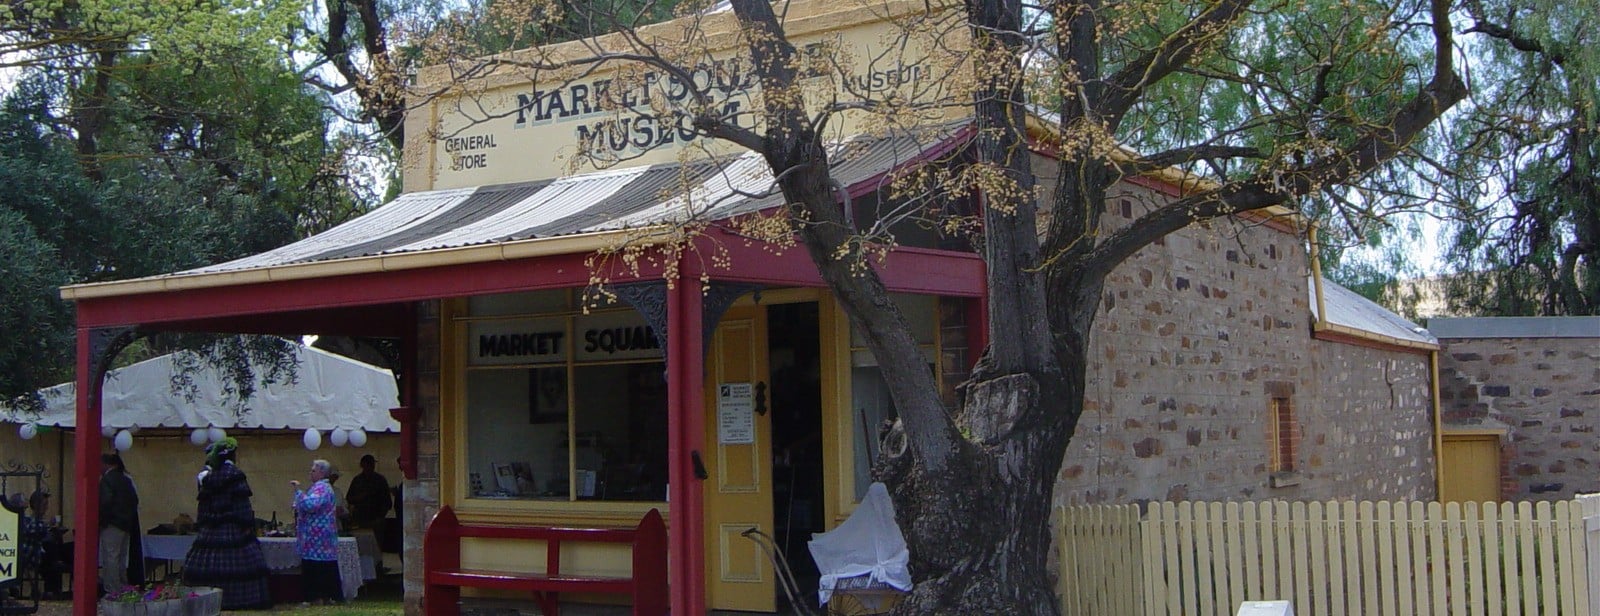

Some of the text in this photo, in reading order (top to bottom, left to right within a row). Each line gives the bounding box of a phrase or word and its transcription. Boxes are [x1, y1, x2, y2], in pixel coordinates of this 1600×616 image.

[515, 71, 657, 124] MARKET
[445, 134, 497, 152] GENERAL
[479, 325, 661, 357] MARKET SQUAR
